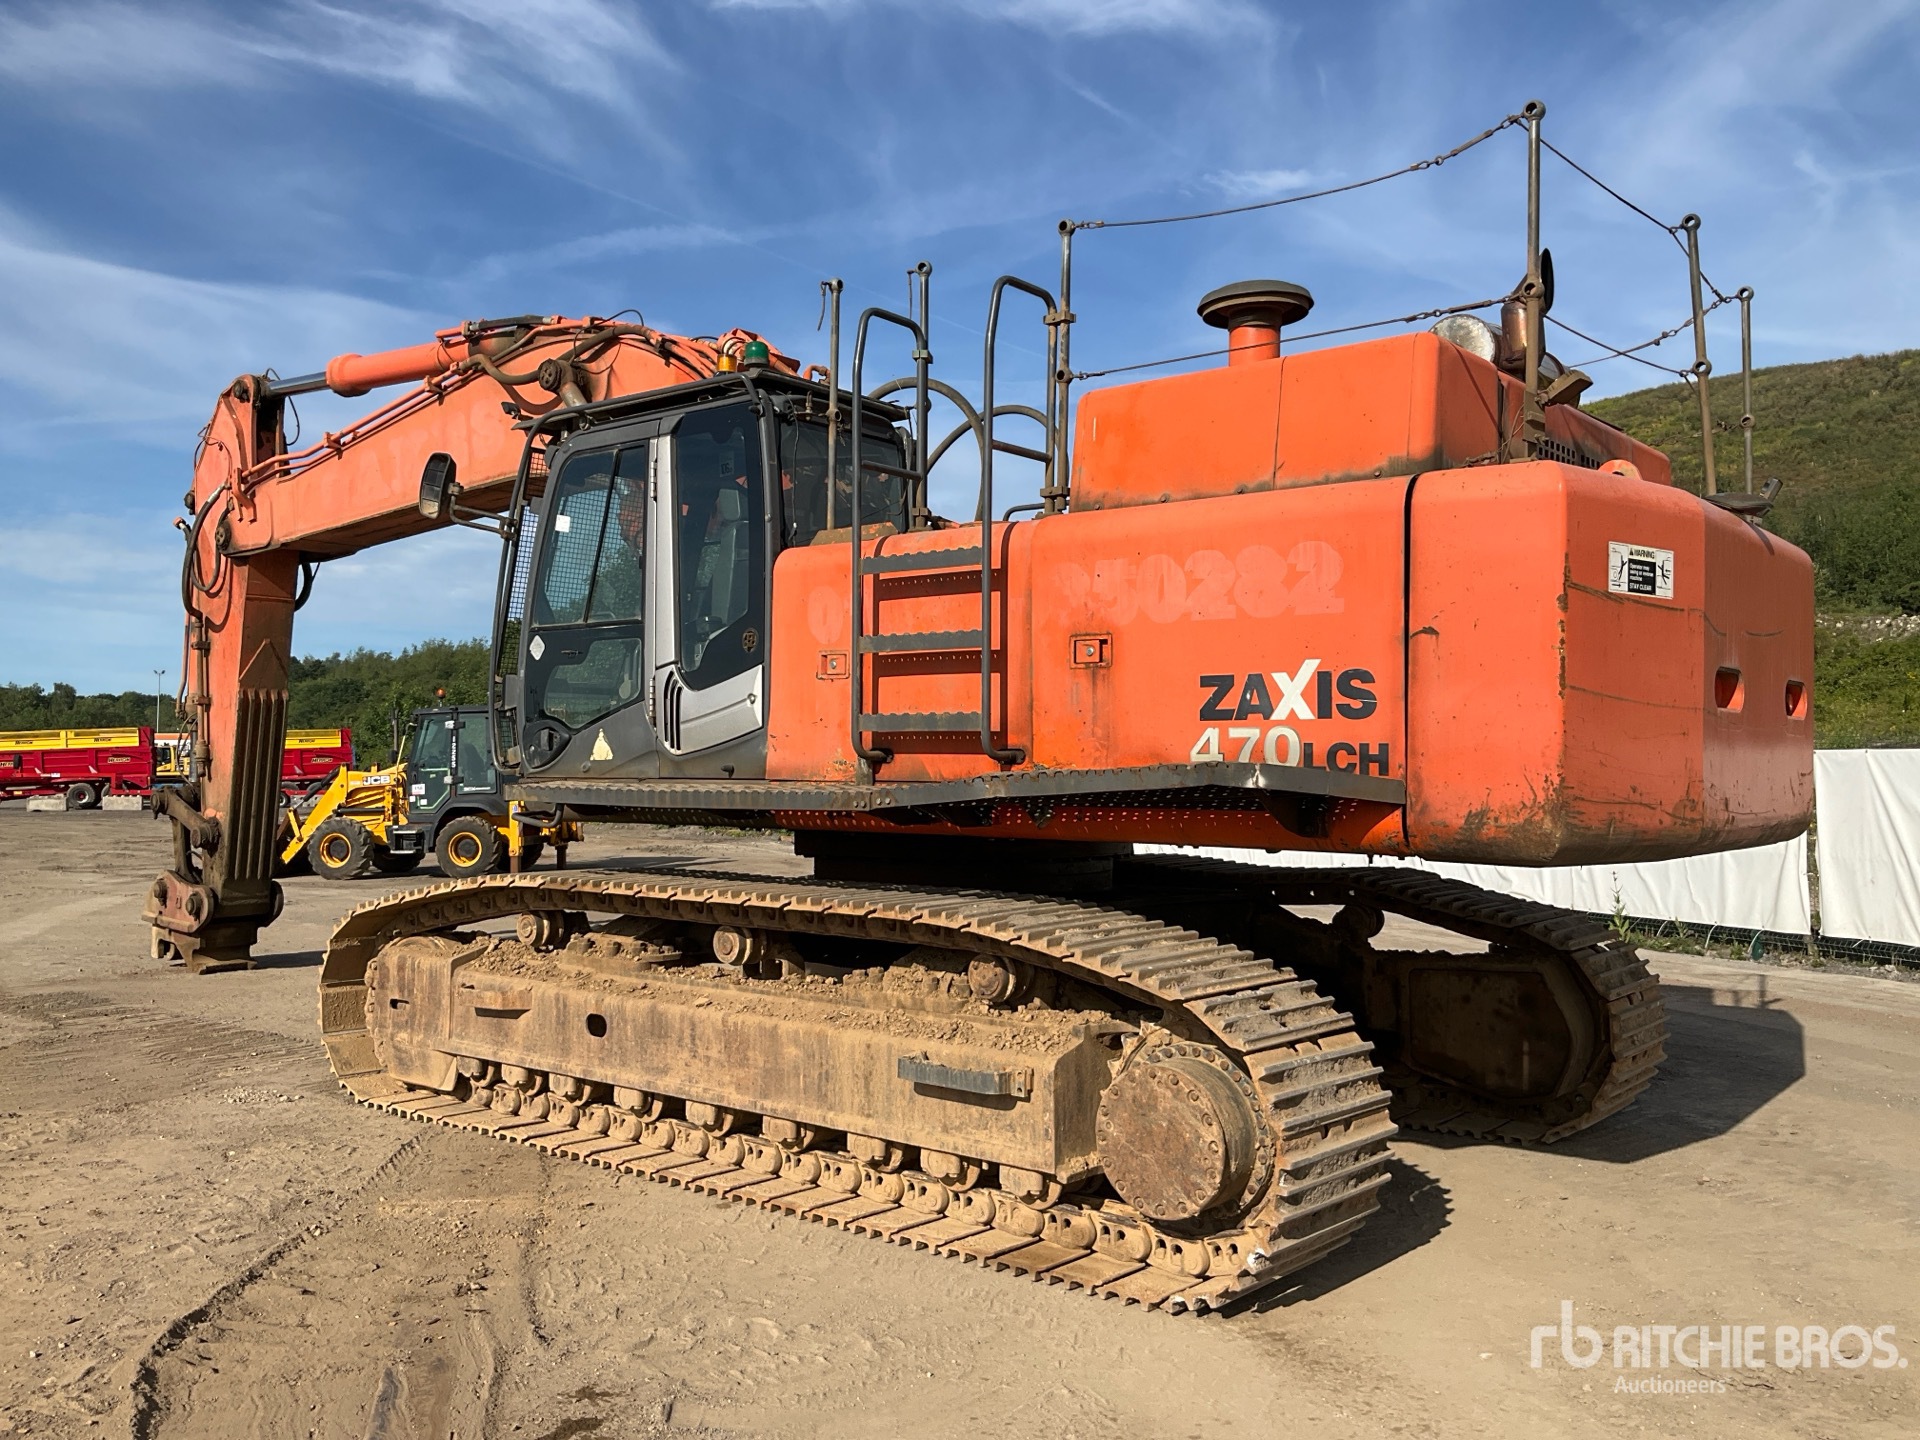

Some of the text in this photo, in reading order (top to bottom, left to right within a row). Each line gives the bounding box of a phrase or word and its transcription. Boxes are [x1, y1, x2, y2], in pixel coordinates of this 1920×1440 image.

[1633, 549, 1655, 559] WARNING
[1629, 582, 1639, 590] STAY
[1199, 658, 1378, 722] ZAXIS
[364, 775, 390, 785] JCB
